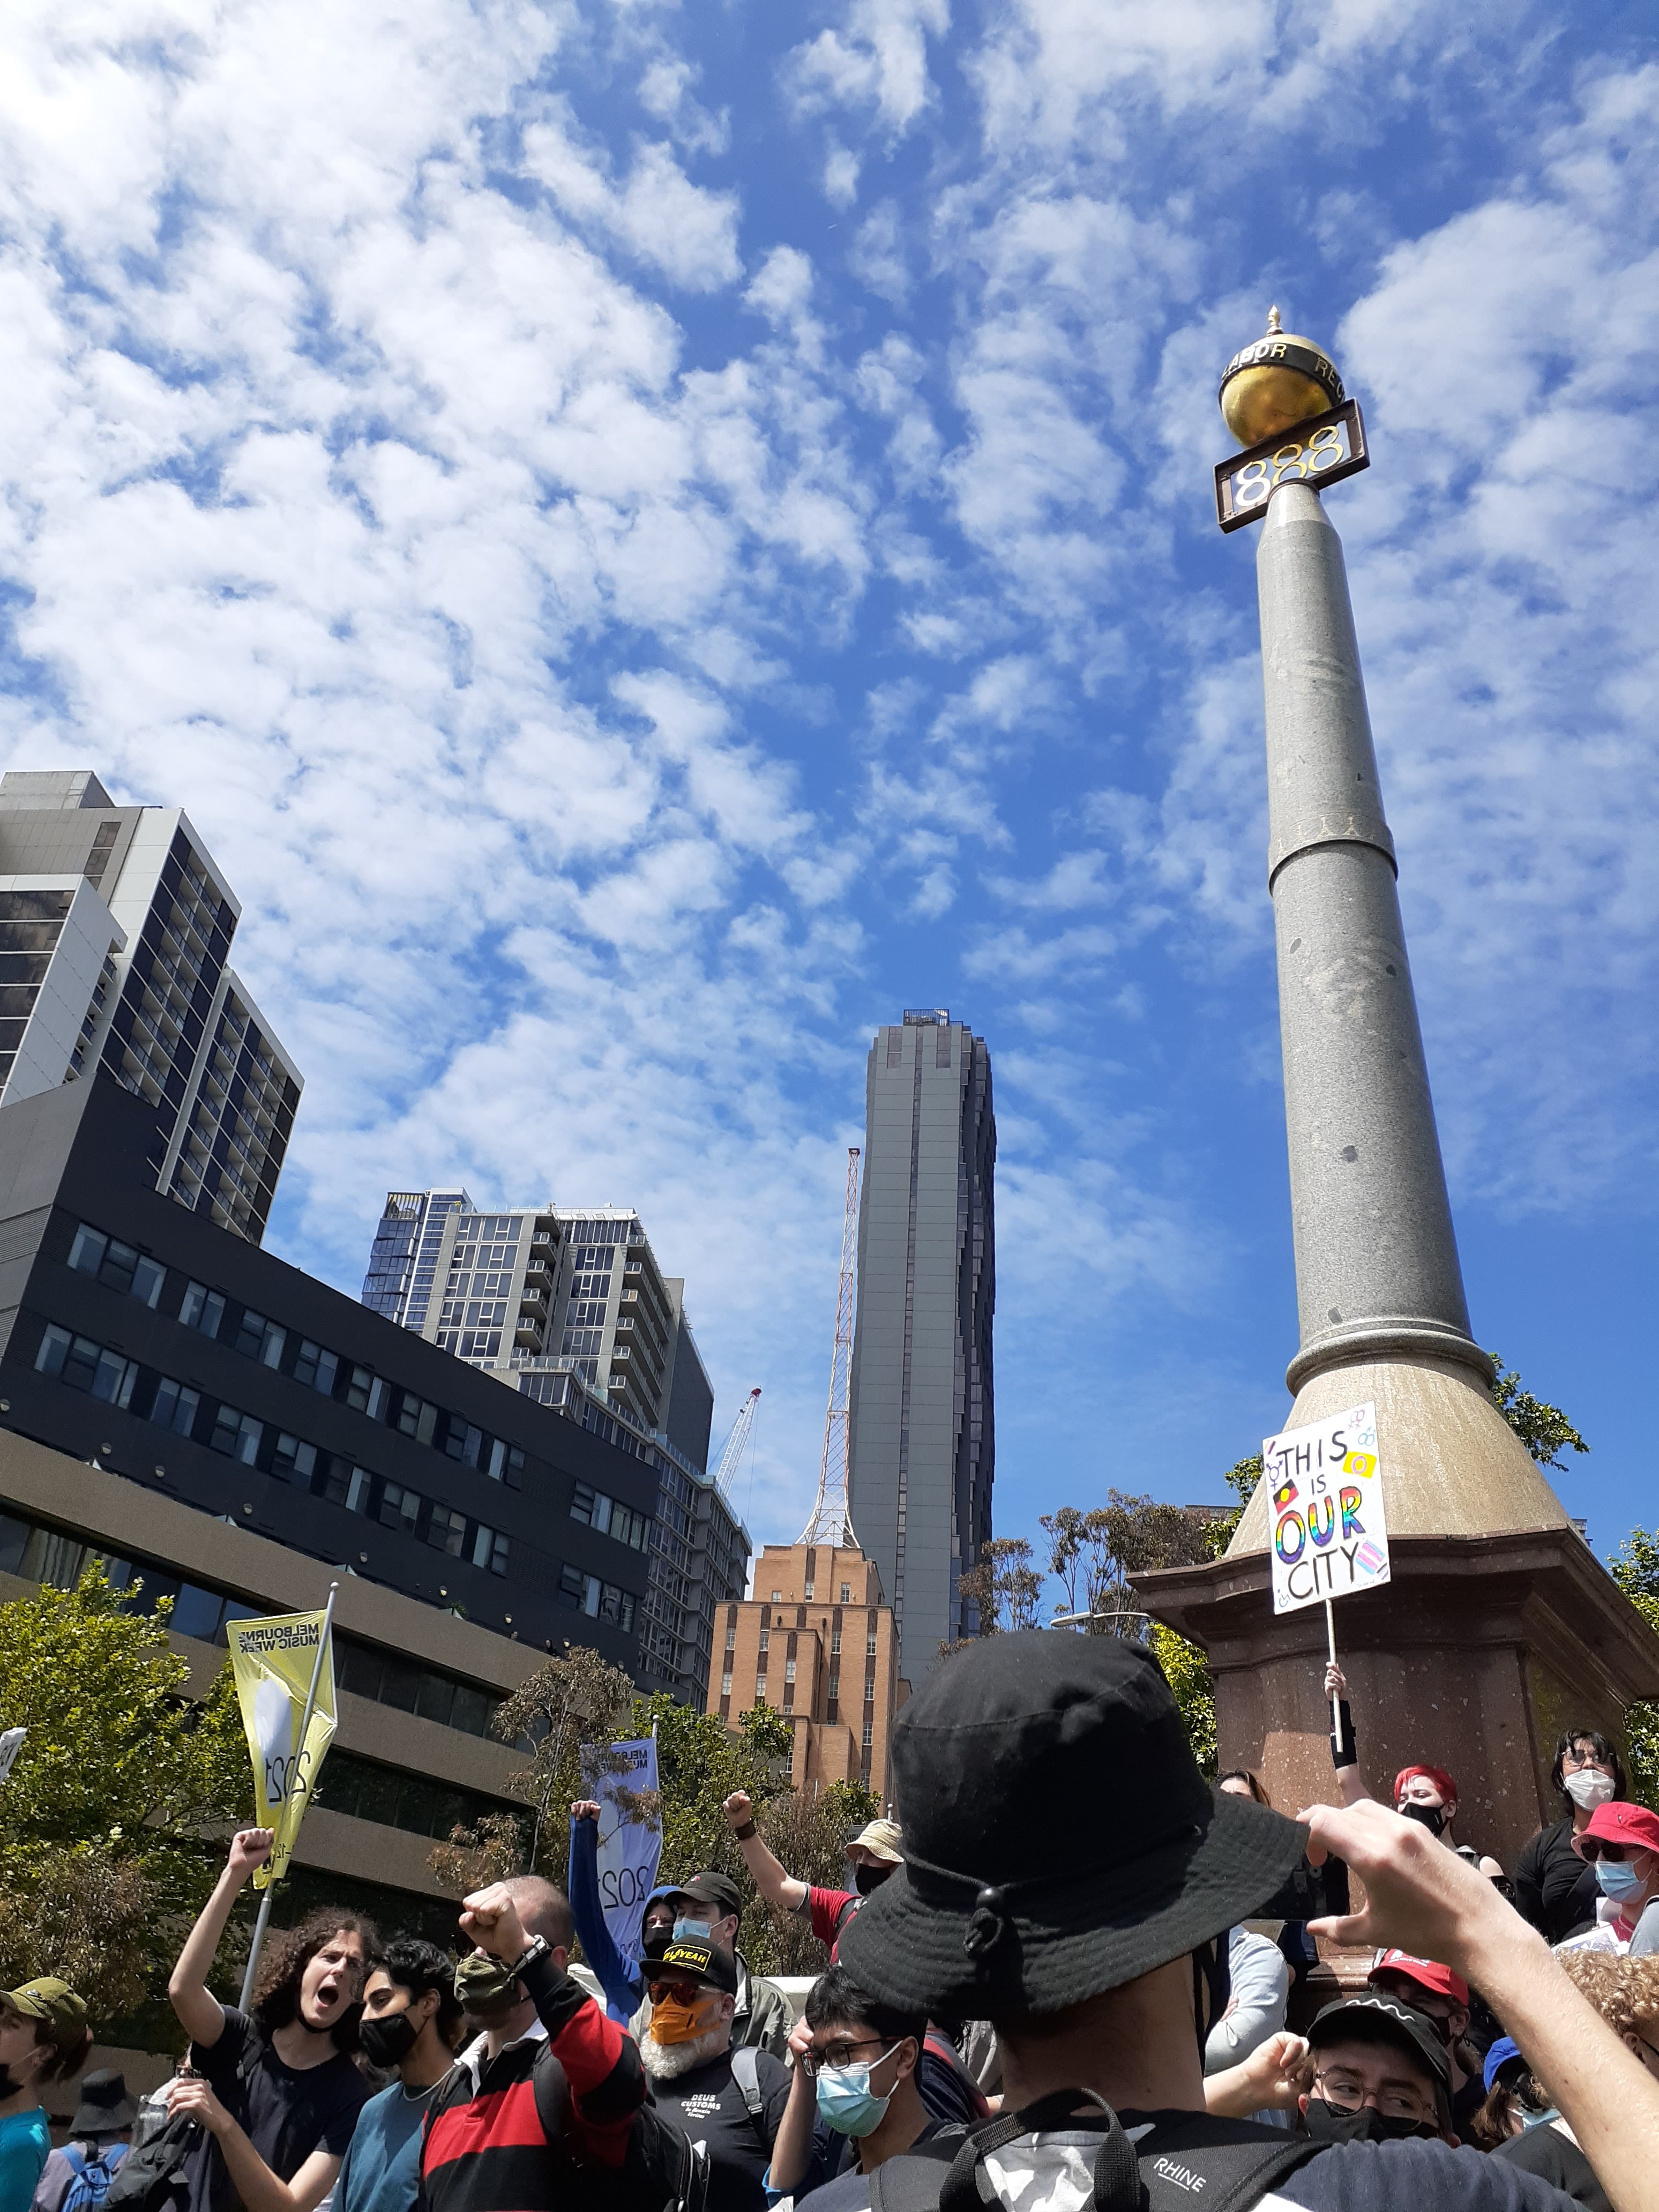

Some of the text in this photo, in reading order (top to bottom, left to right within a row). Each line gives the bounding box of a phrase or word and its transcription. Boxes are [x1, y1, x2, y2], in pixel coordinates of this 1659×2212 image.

[1222, 342, 1287, 381] LABOR
[1236, 425, 1343, 506] 888
[1276, 1431, 1348, 1479] THIS
[1311, 1474, 1326, 1495] IS
[1276, 1486, 1366, 1564] OUR
[1288, 1542, 1359, 1599] CITY
[681, 2101, 721, 2110] CUSTOMS
[1153, 2157, 1206, 2192] RHINE
